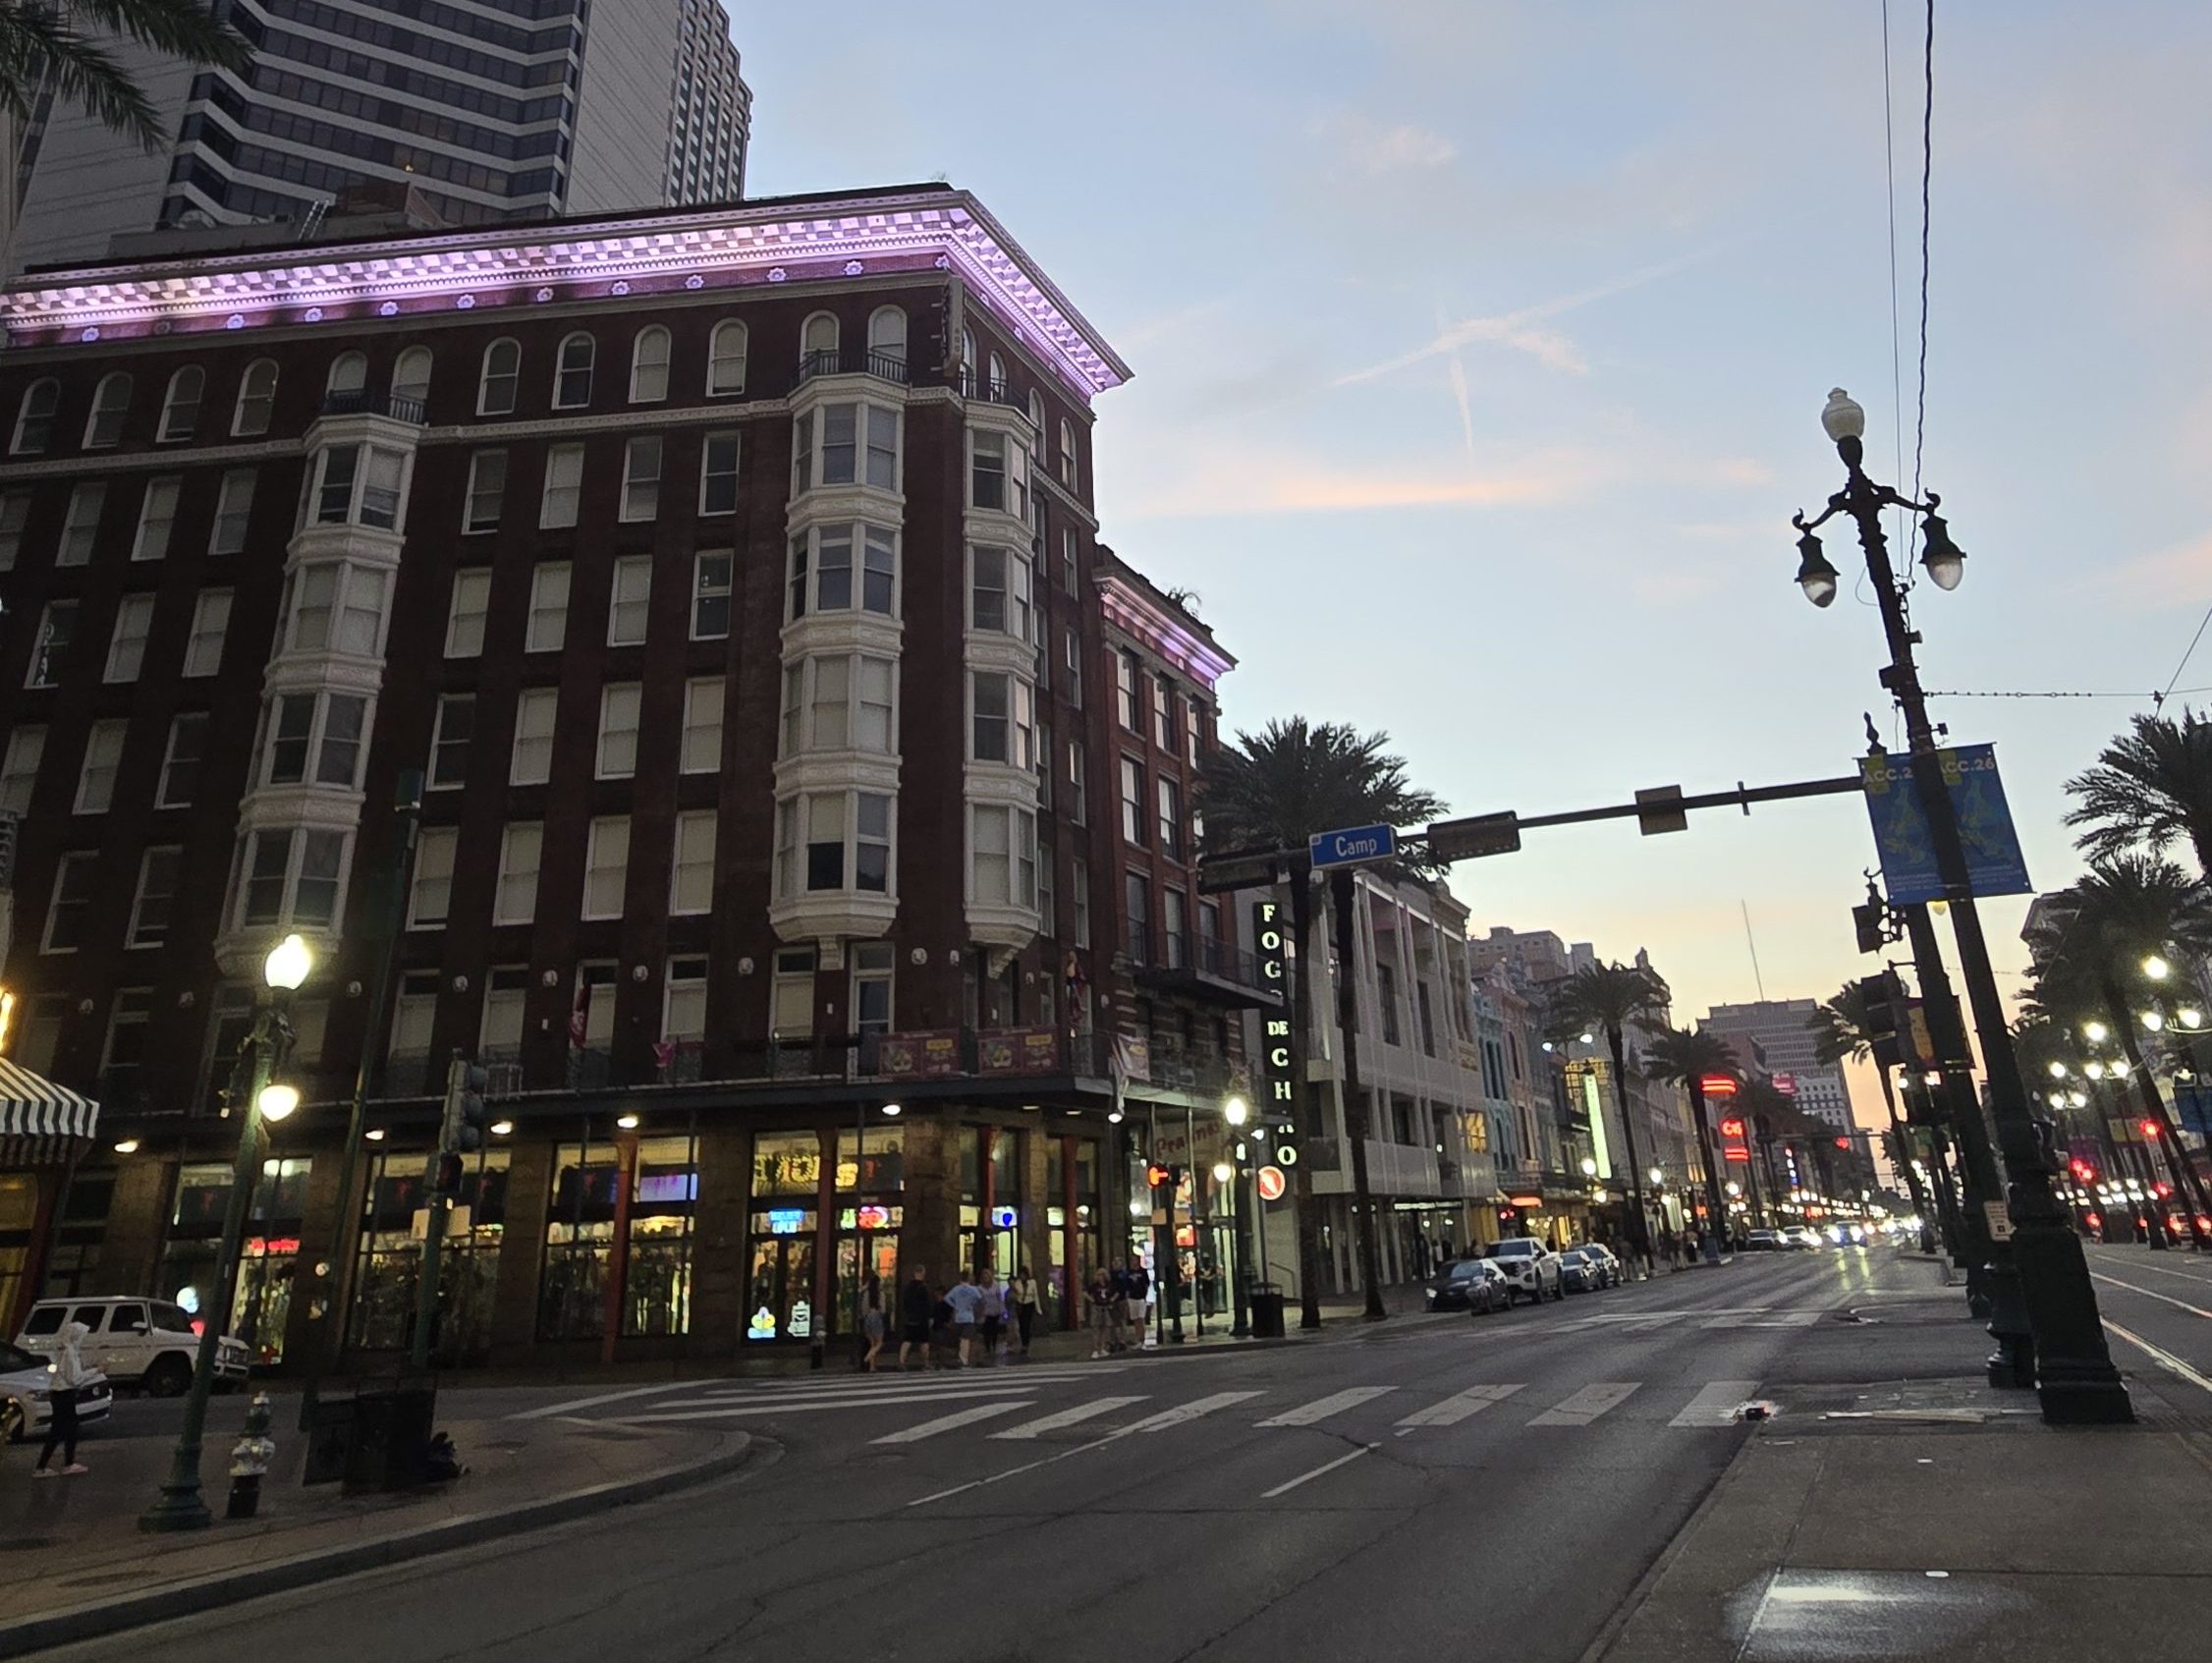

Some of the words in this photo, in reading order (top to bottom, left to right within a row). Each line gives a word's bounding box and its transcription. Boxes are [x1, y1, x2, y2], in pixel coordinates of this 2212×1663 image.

[1862, 767, 1913, 784] ACC.2
[1336, 836, 1377, 857] Camp
[1267, 1021, 1289, 1035] DE
